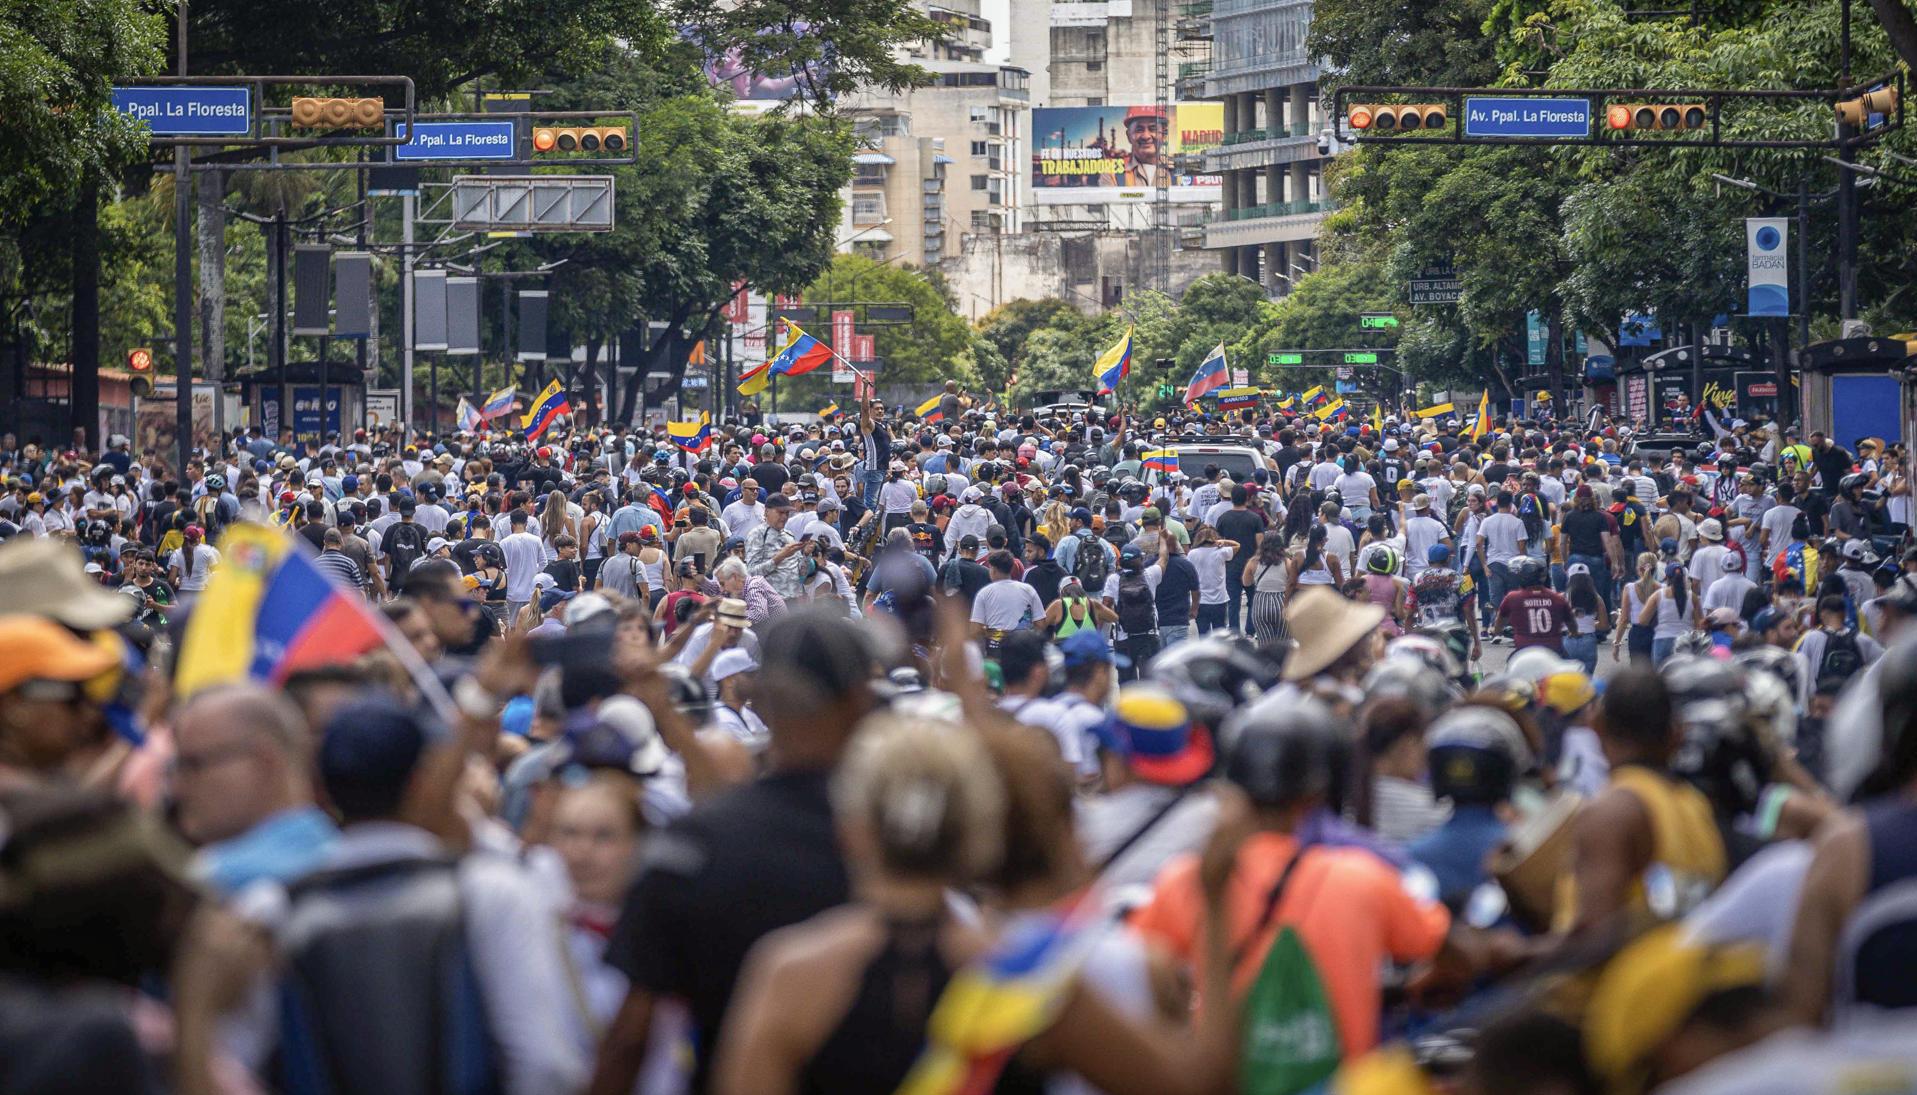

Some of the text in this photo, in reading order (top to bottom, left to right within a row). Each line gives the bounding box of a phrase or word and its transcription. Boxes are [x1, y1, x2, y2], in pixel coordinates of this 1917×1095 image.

[128, 102, 163, 120] Ppal.
[166, 102, 184, 116] La
[187, 102, 245, 117] Floresta
[1470, 109, 1585, 125] Av. Ppal. La Floresta
[420, 134, 446, 149] Ppal.
[449, 134, 463, 145] La
[465, 133, 508, 145] Floresta
[1181, 130, 1223, 146] MADUR
[1063, 148, 1103, 160] NUESTROS
[1040, 158, 1125, 175] TRABAJADORES
[1413, 282, 1432, 291] URB.
[1414, 292, 1427, 301] AV.
[1529, 608, 1552, 633] 10
